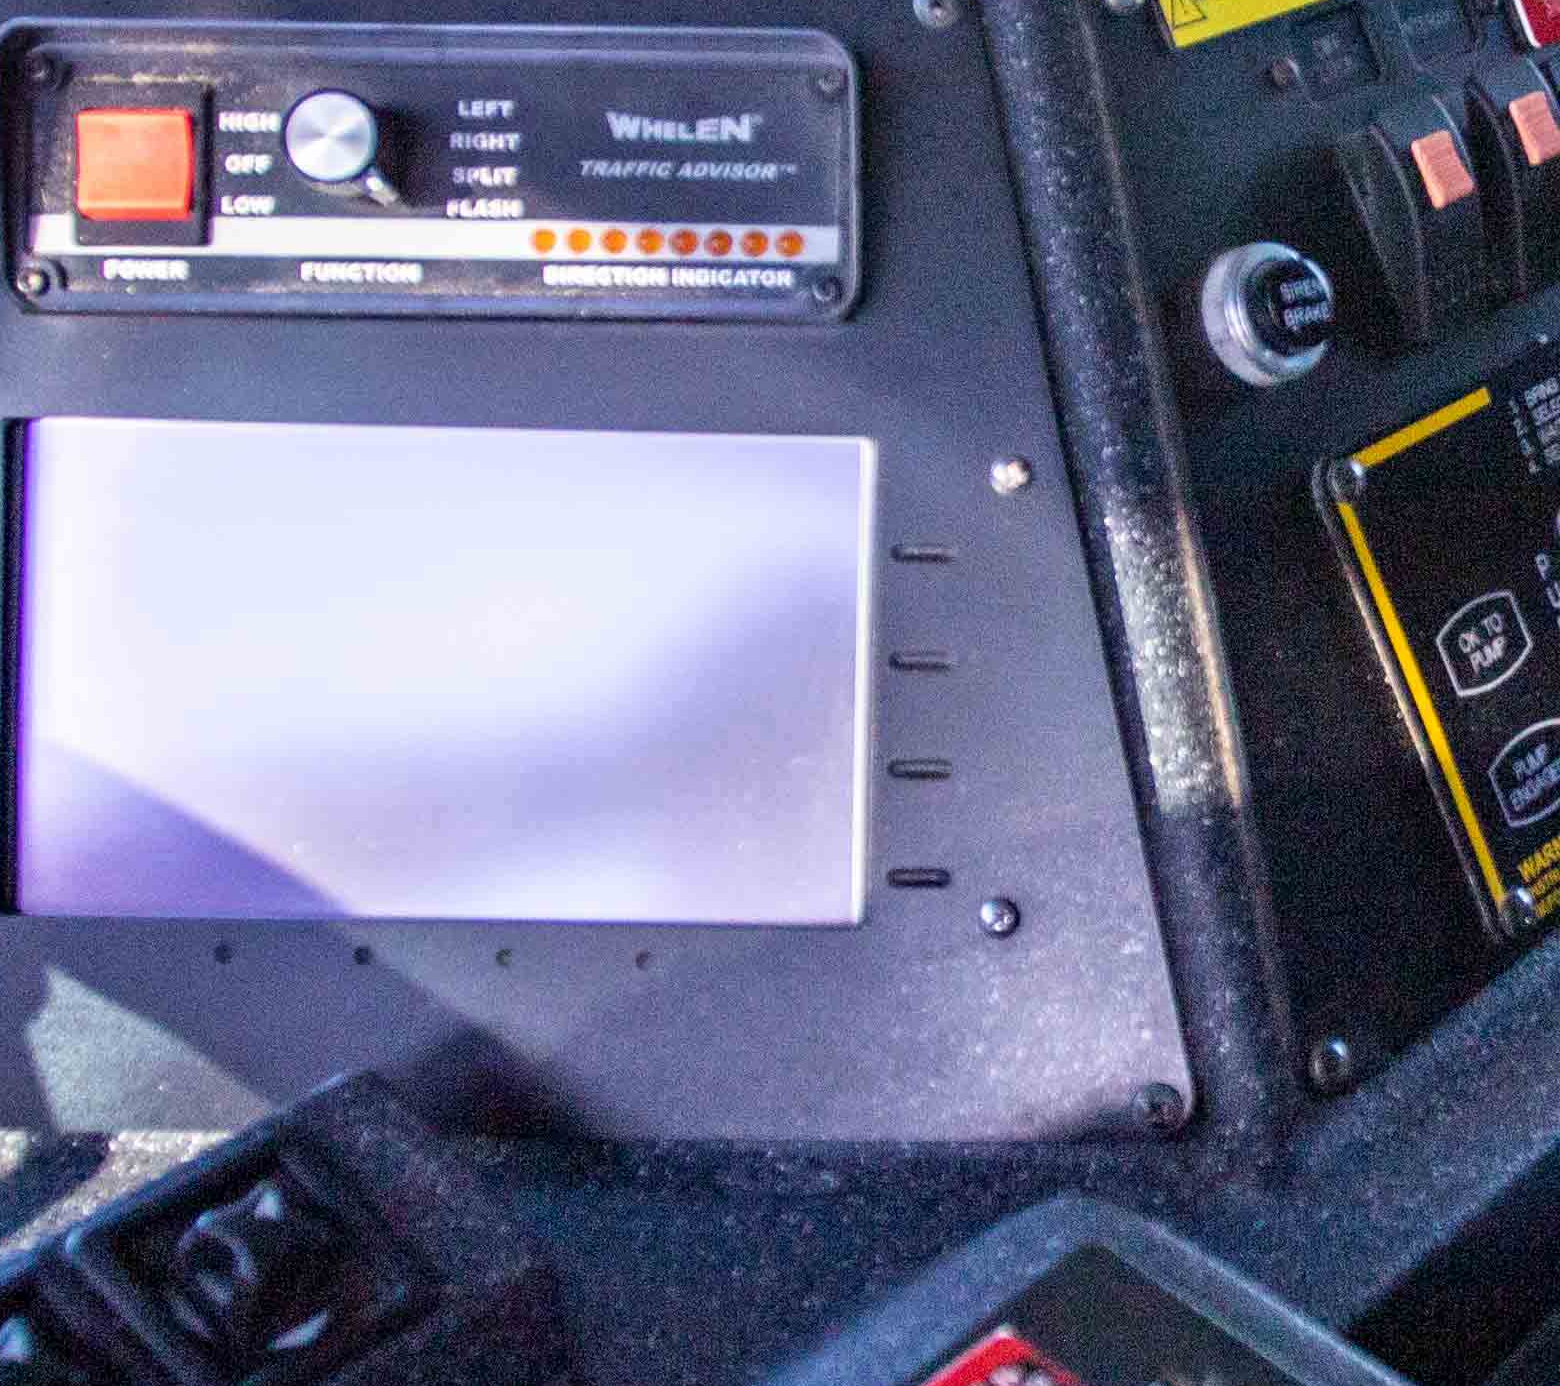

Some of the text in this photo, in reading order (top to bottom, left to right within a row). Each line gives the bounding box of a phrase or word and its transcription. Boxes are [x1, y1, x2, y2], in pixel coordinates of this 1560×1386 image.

[458, 100, 514, 120] LEFT
[219, 111, 280, 134] HIGH
[604, 111, 752, 143] WHELEN
[450, 132, 520, 153] RIGHT
[225, 153, 271, 176] OFF
[580, 159, 671, 179] TRAFFIC
[453, 165, 516, 187] SPLIT
[221, 196, 274, 216] LOW
[447, 198, 524, 219] FLASH
[104, 259, 189, 281] POWER
[301, 262, 422, 284] FUNCTION
[544, 265, 793, 288] DIRECTION INDICATOR
[1284, 301, 1330, 328] BRAKE
[1460, 612, 1504, 653] OK TO
[1470, 636, 1505, 671] PUMP
[1514, 744, 1547, 776] PUMP
